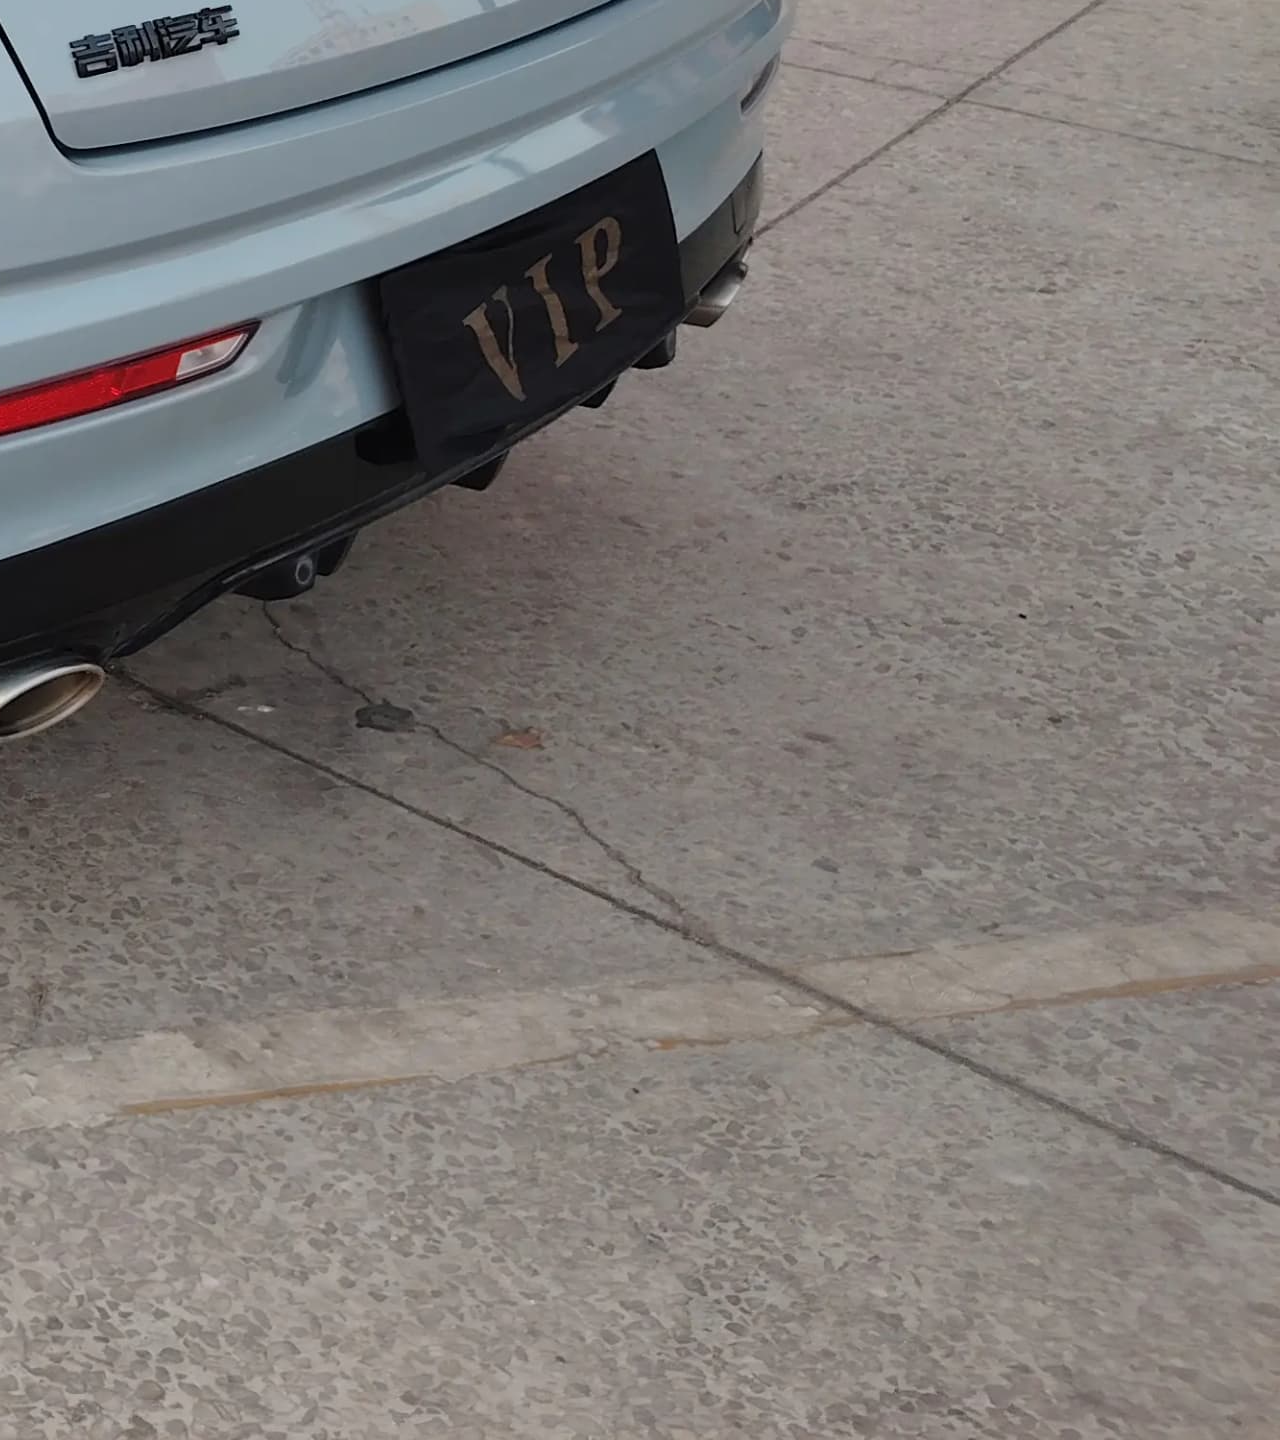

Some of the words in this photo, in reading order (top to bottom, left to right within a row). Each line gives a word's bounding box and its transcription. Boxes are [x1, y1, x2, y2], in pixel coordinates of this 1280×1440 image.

[69, 5, 240, 79] 吉利汽车
[462, 216, 623, 402] VIP
